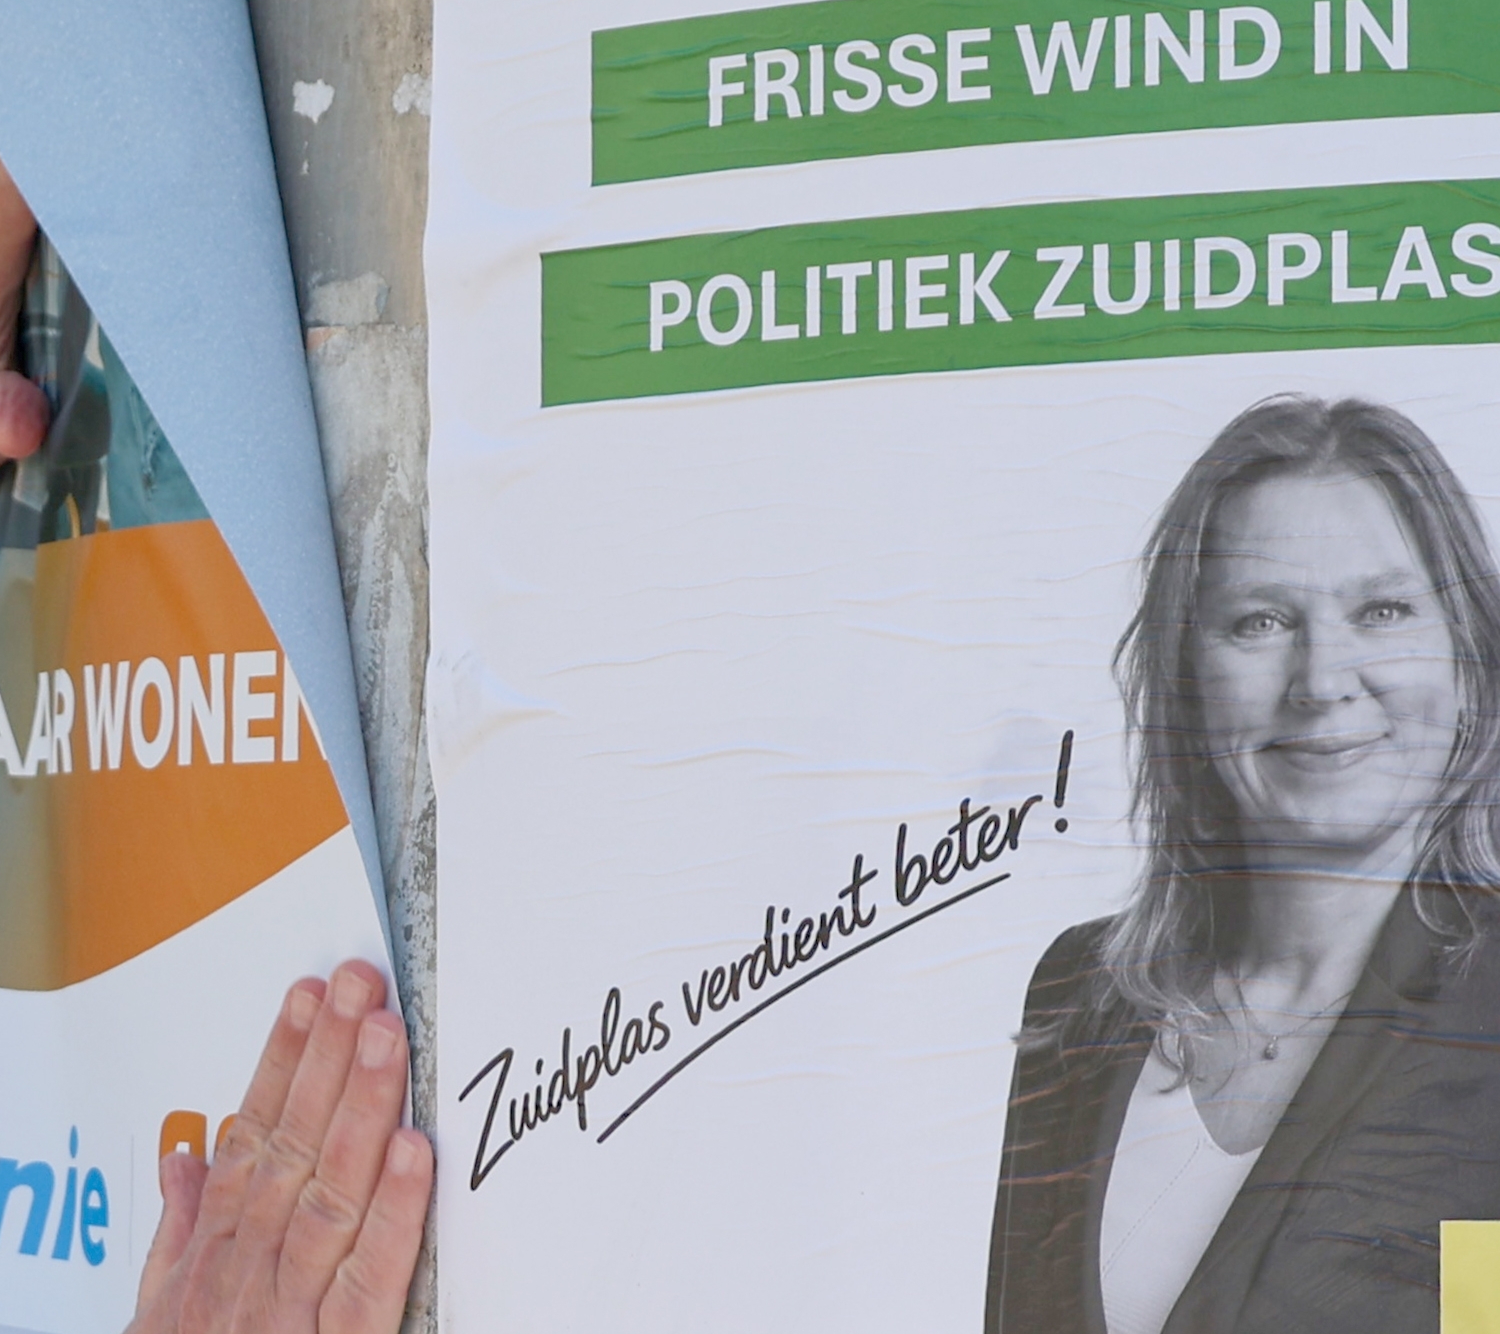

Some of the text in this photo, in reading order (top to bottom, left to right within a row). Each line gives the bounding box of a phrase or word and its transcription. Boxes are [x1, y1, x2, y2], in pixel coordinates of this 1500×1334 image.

[706, 28, 992, 128] FRISSE
[1015, 7, 1282, 98] WIND
[648, 250, 1012, 352] POLITIEK
[459, 729, 1074, 1192] Zuidplas verdient beter!
